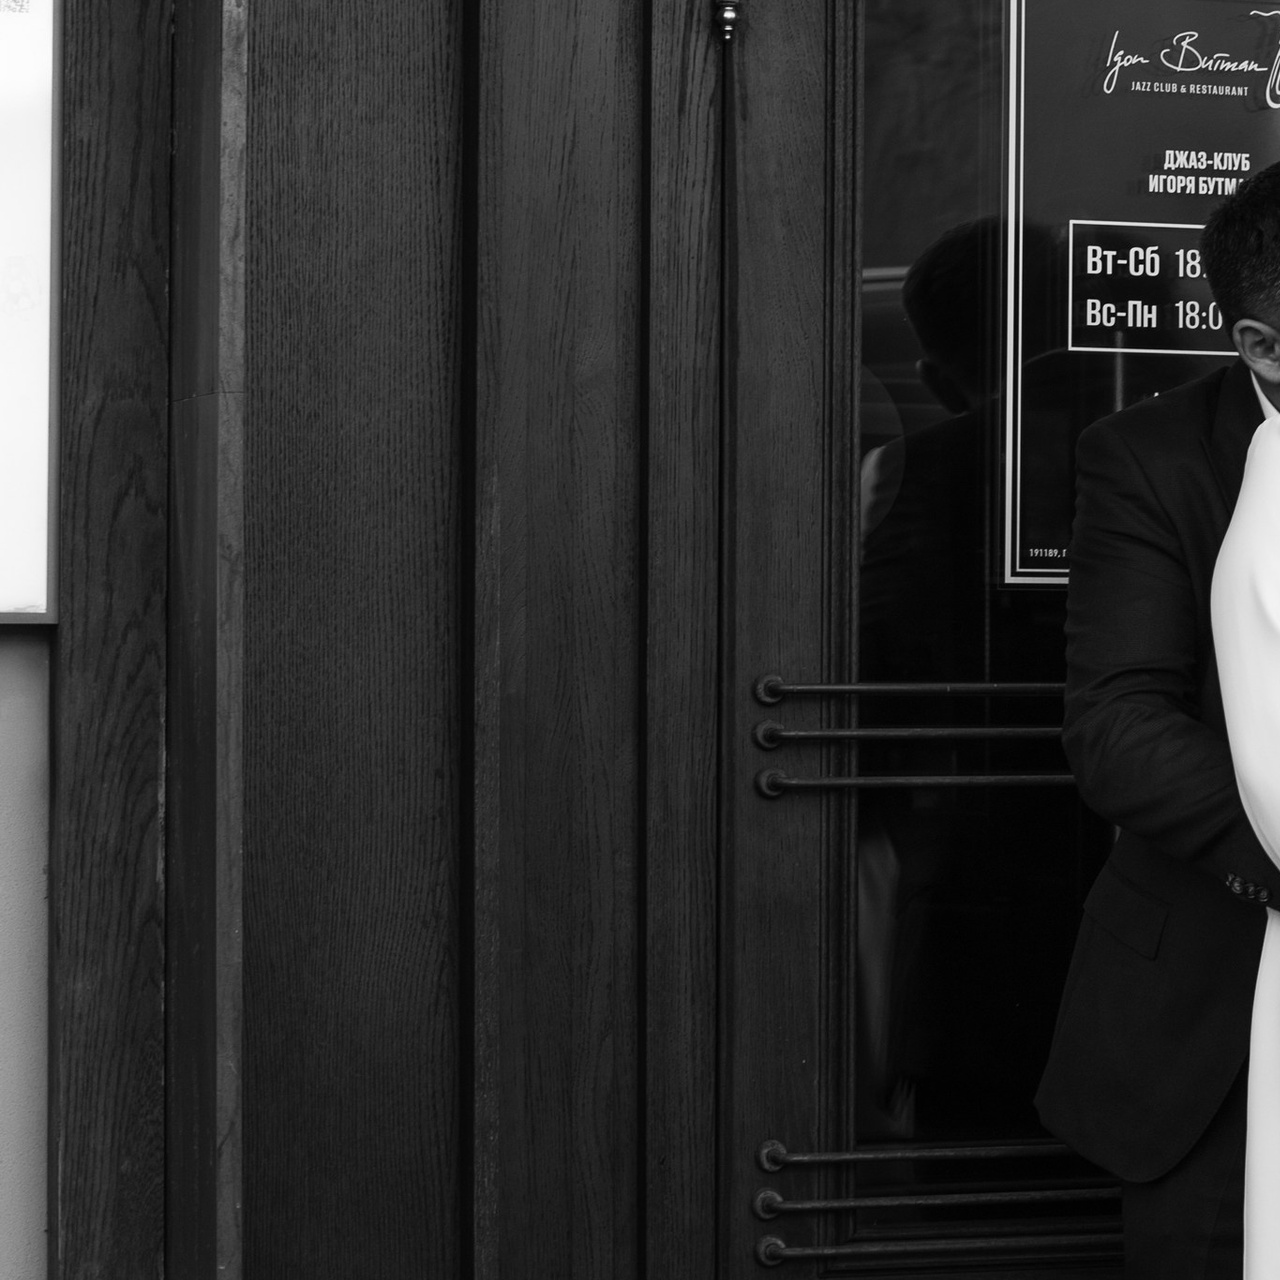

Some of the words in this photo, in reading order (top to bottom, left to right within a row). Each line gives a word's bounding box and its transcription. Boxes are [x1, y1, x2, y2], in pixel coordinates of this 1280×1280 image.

[1131, 81, 1151, 92] JAZZ
[1153, 82, 1178, 93] CLUB
[1180, 84, 1187, 94] &
[1189, 84, 1249, 96] RESTAURANT
[1163, 149, 1250, 171] ДЖАЗ-КЛУБ
[1148, 174, 1196, 194] ИГОРЯ
[1198, 176, 1244, 195] БУТМ
[1087, 245, 1160, 277] Вт-Сб
[1086, 298, 1157, 328] Вс-Пн
[1029, 548, 1061, 558] 191189,
